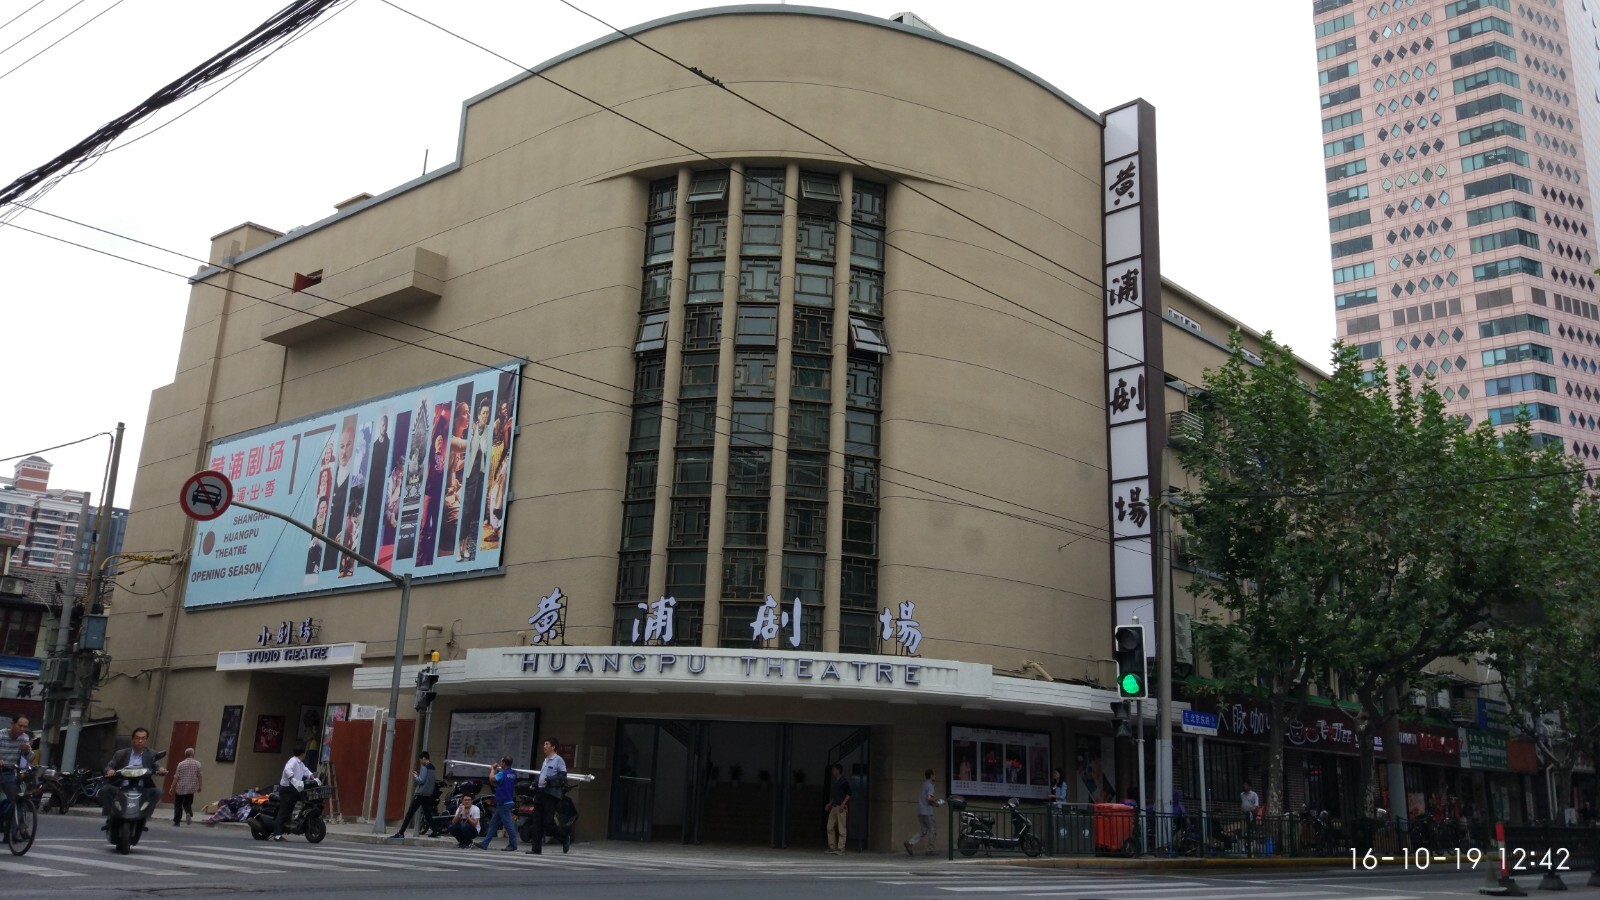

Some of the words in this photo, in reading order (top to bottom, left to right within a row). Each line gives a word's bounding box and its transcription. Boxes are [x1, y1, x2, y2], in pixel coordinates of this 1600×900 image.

[209, 440, 285, 481] 黄浦剧场
[224, 528, 259, 543] HUANGPU
[215, 545, 247, 559] THEATRE
[191, 568, 226, 582] OPENING
[228, 562, 262, 577] SEASON
[247, 649, 280, 663] STUDIO
[284, 647, 329, 661] THEATRE
[521, 652, 706, 674] HUANGPU
[741, 655, 921, 685] THEATRE
